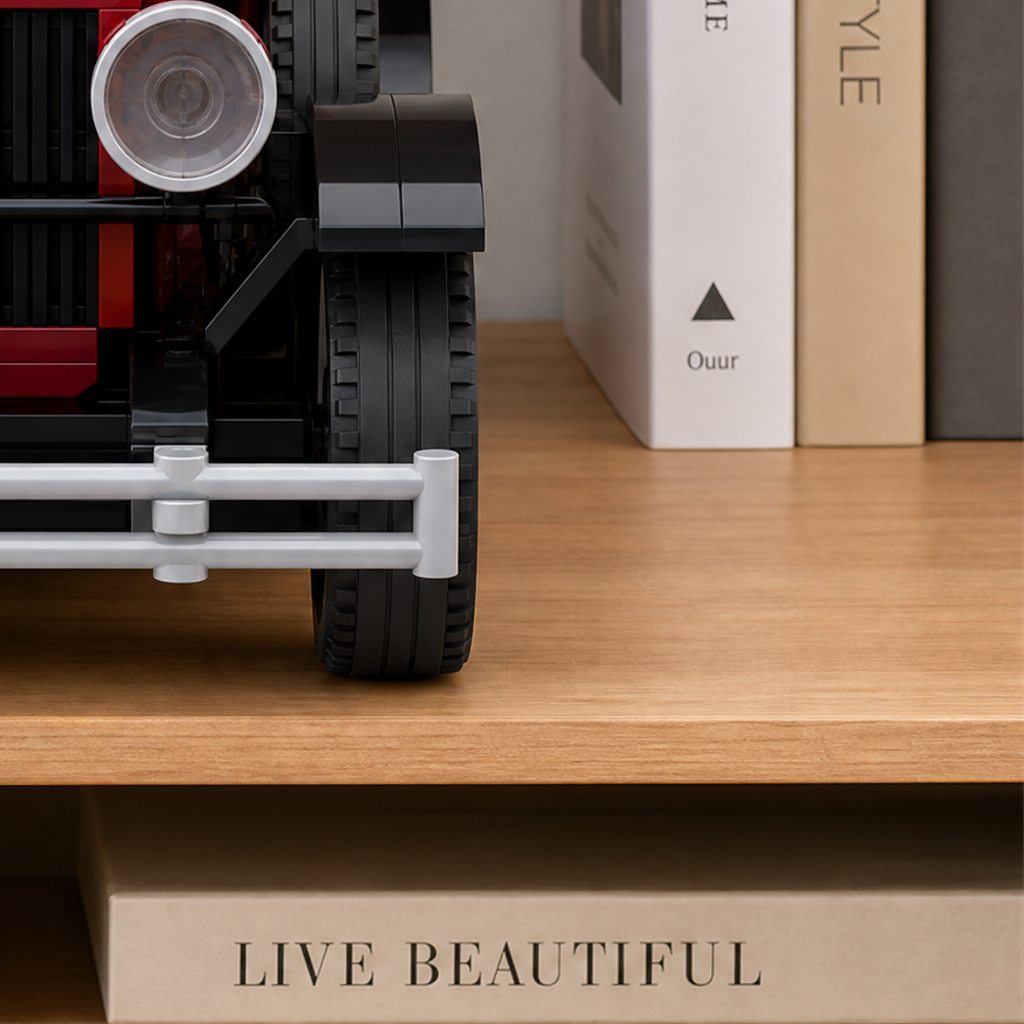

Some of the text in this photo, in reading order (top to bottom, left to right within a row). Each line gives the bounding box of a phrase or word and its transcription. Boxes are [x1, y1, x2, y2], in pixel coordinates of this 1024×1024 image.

[686, 350, 740, 372] Ouur
[234, 941, 763, 987] LIVE BEAUTIFUL
